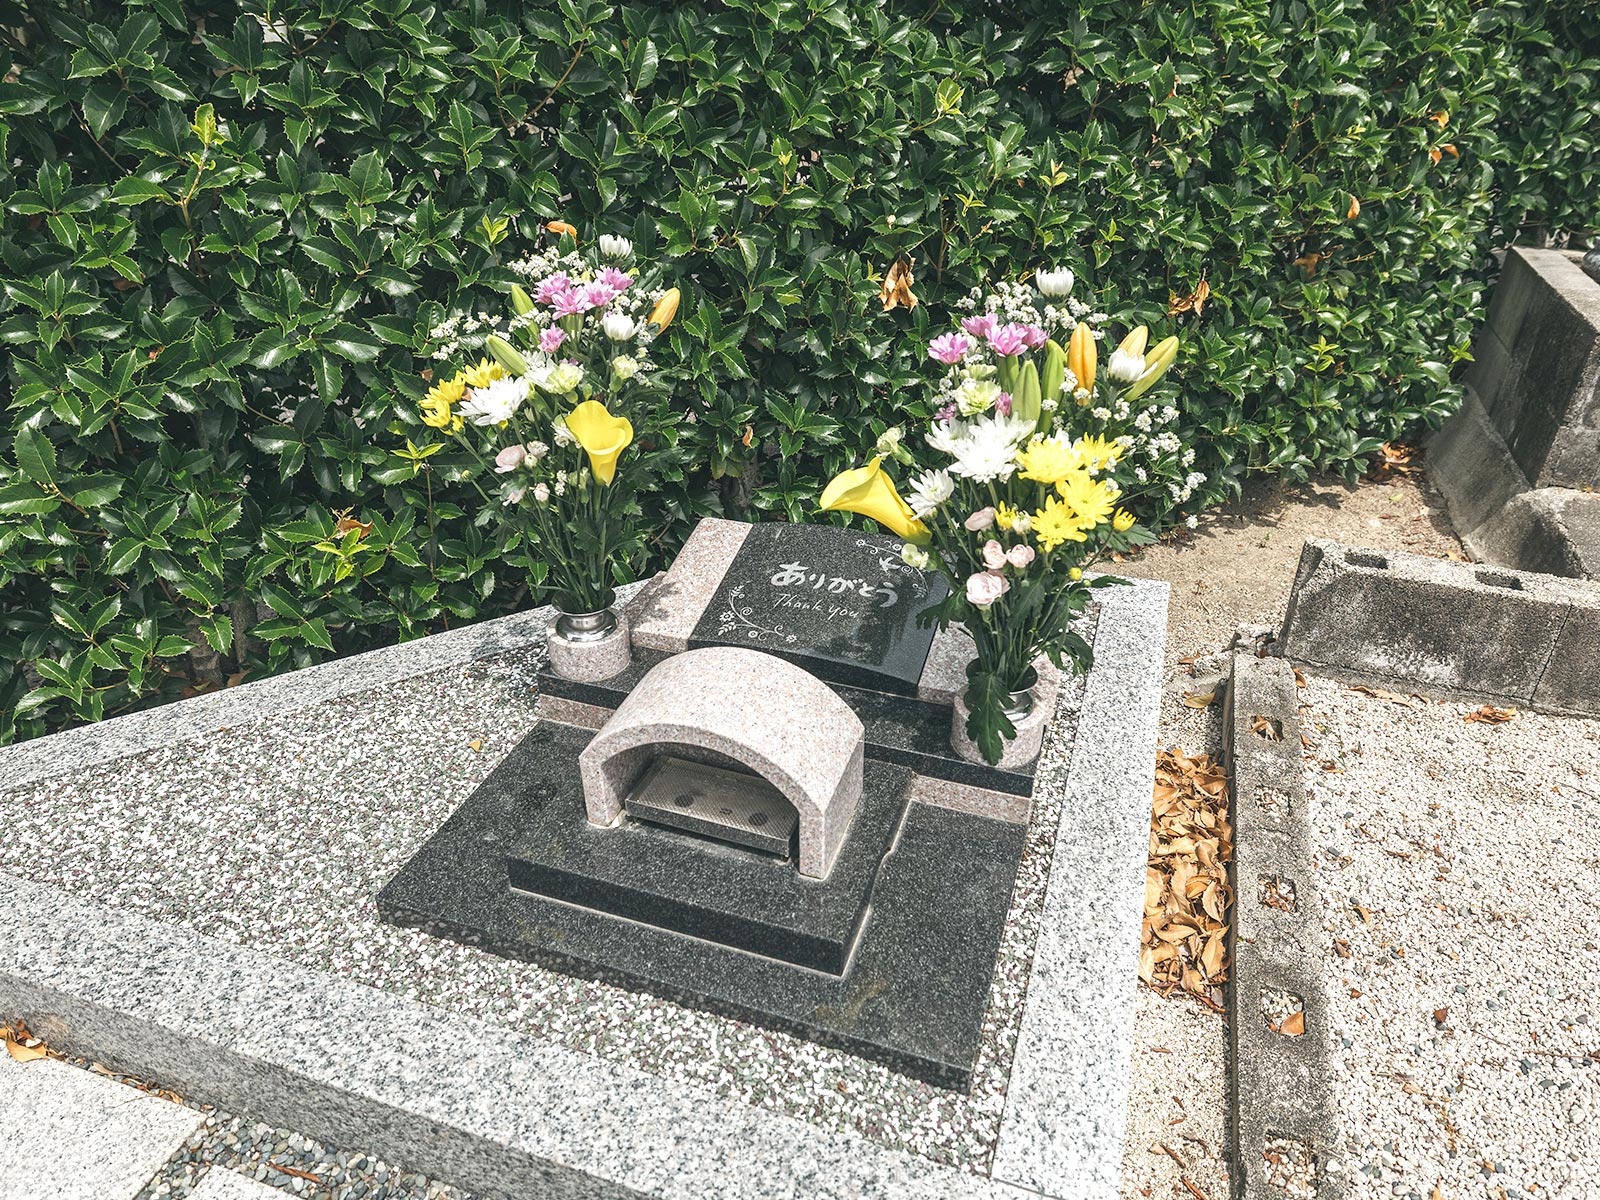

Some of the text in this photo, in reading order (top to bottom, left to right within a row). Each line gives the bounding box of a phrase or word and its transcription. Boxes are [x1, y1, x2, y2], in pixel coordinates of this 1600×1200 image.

[771, 561, 899, 608] ありがとう
[773, 593, 860, 620] Thank you
